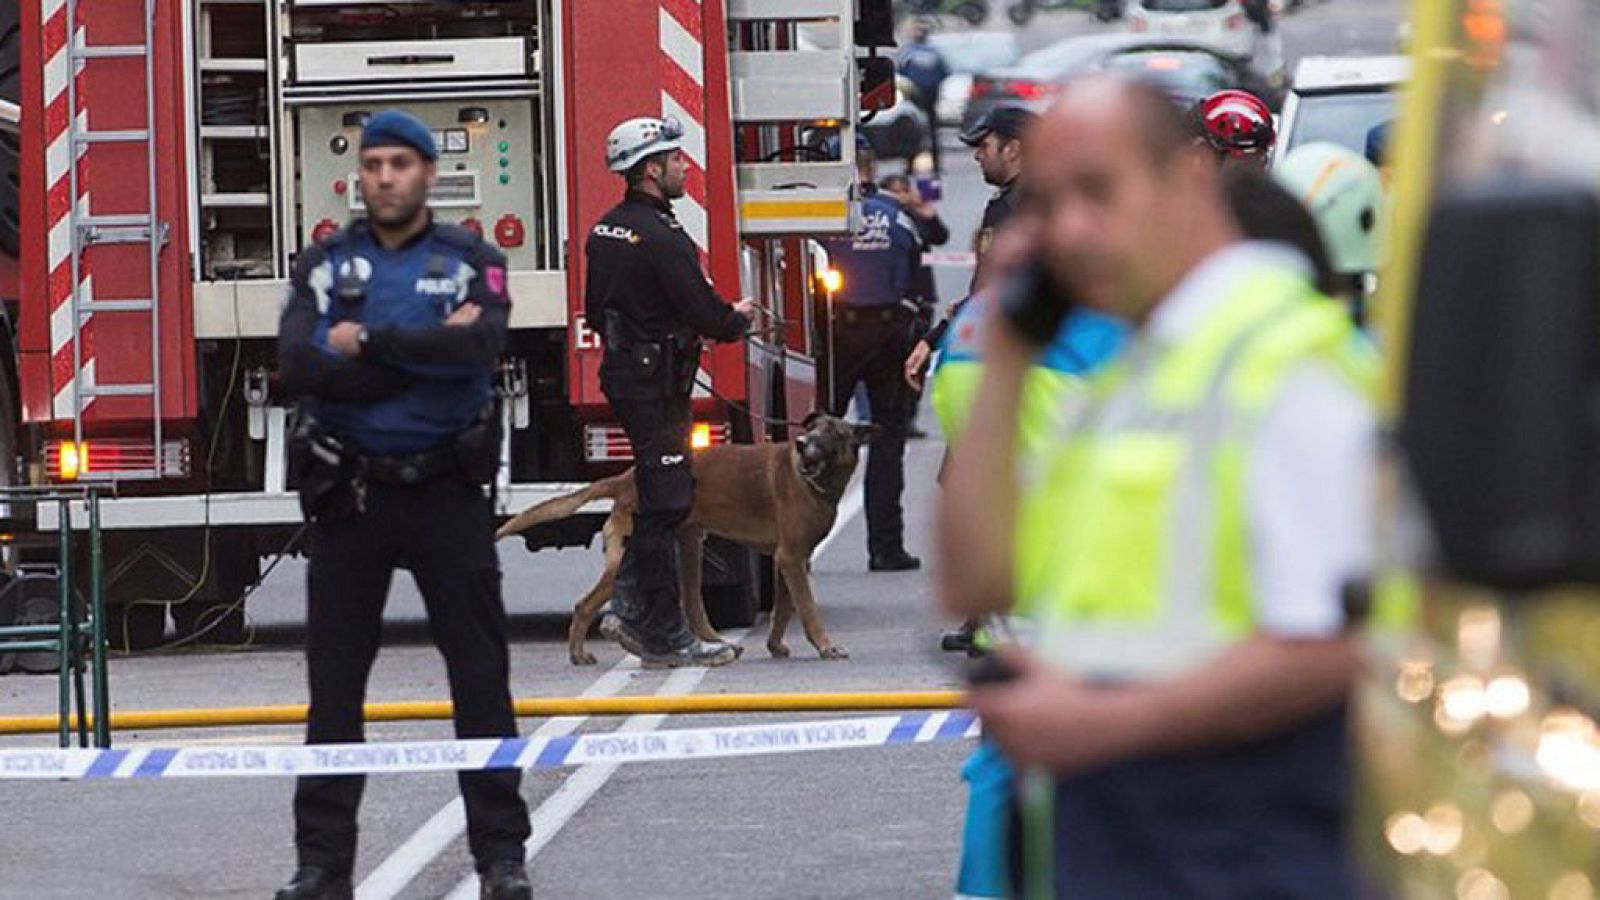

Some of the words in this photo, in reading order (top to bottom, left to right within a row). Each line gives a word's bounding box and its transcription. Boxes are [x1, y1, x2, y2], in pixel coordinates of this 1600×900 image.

[585, 739, 640, 757] PASAR
[644, 737, 668, 753] NO
[710, 730, 799, 750] MUNICIPAL
[184, 752, 239, 769] PASAR
[242, 751, 267, 769] NO
